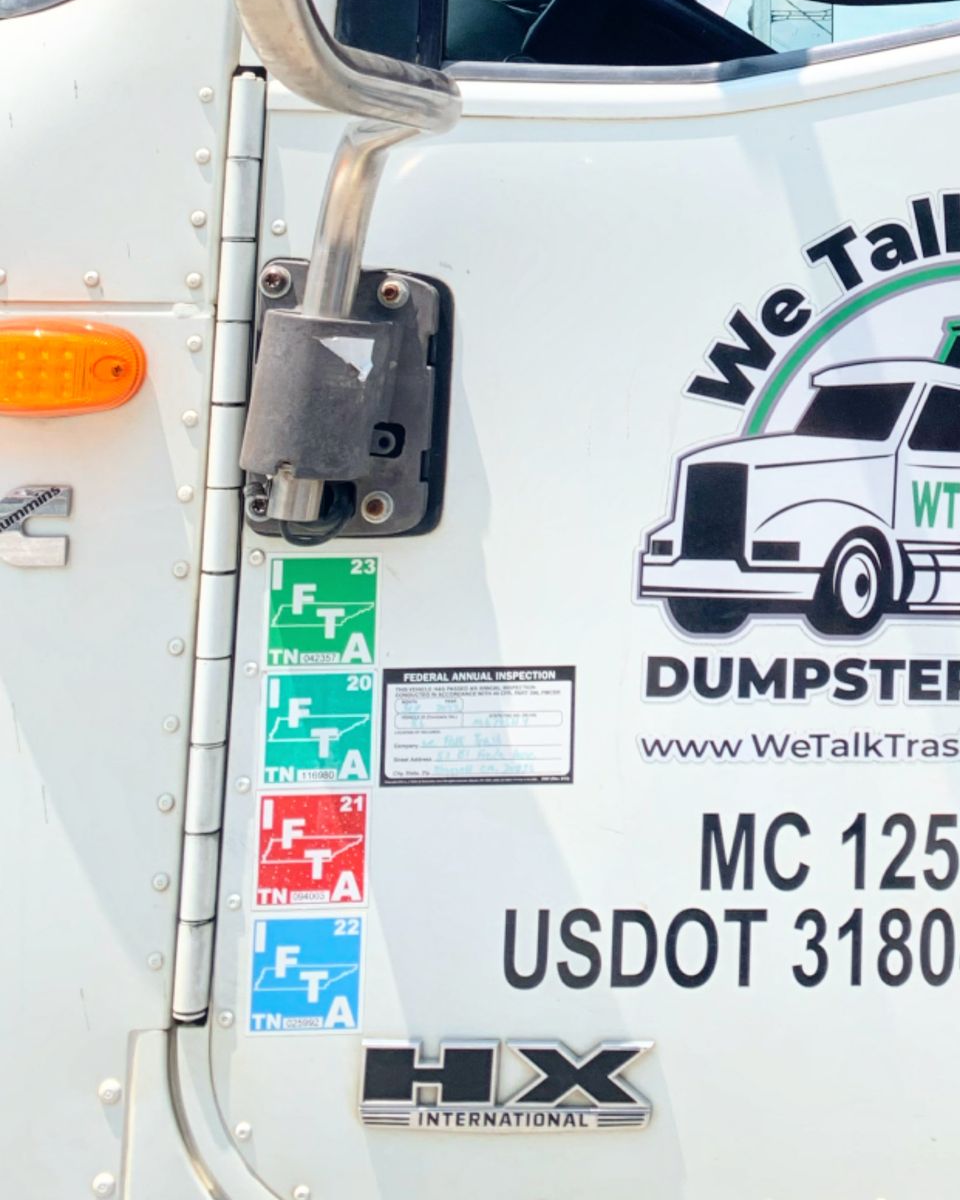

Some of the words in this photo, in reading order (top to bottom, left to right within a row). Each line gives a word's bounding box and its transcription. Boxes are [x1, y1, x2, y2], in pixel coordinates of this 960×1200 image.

[686, 288, 812, 406] We
[350, 559, 376, 575] 23
[268, 648, 299, 665] TN
[346, 675, 372, 691] 20
[403, 672, 449, 682] FEDERAL
[451, 671, 492, 681] ANNUAL
[495, 670, 556, 680] INSPECTION
[641, 738, 742, 758] www
[264, 766, 295, 782] TN
[339, 796, 363, 812] 21
[700, 812, 811, 891] MC
[257, 888, 287, 905] TN
[333, 919, 360, 936] 22
[503, 908, 768, 990] USDOT
[251, 1013, 282, 1030] TN
[362, 1039, 655, 1107] HX
[418, 1112, 589, 1128] INTERNATIONAL
